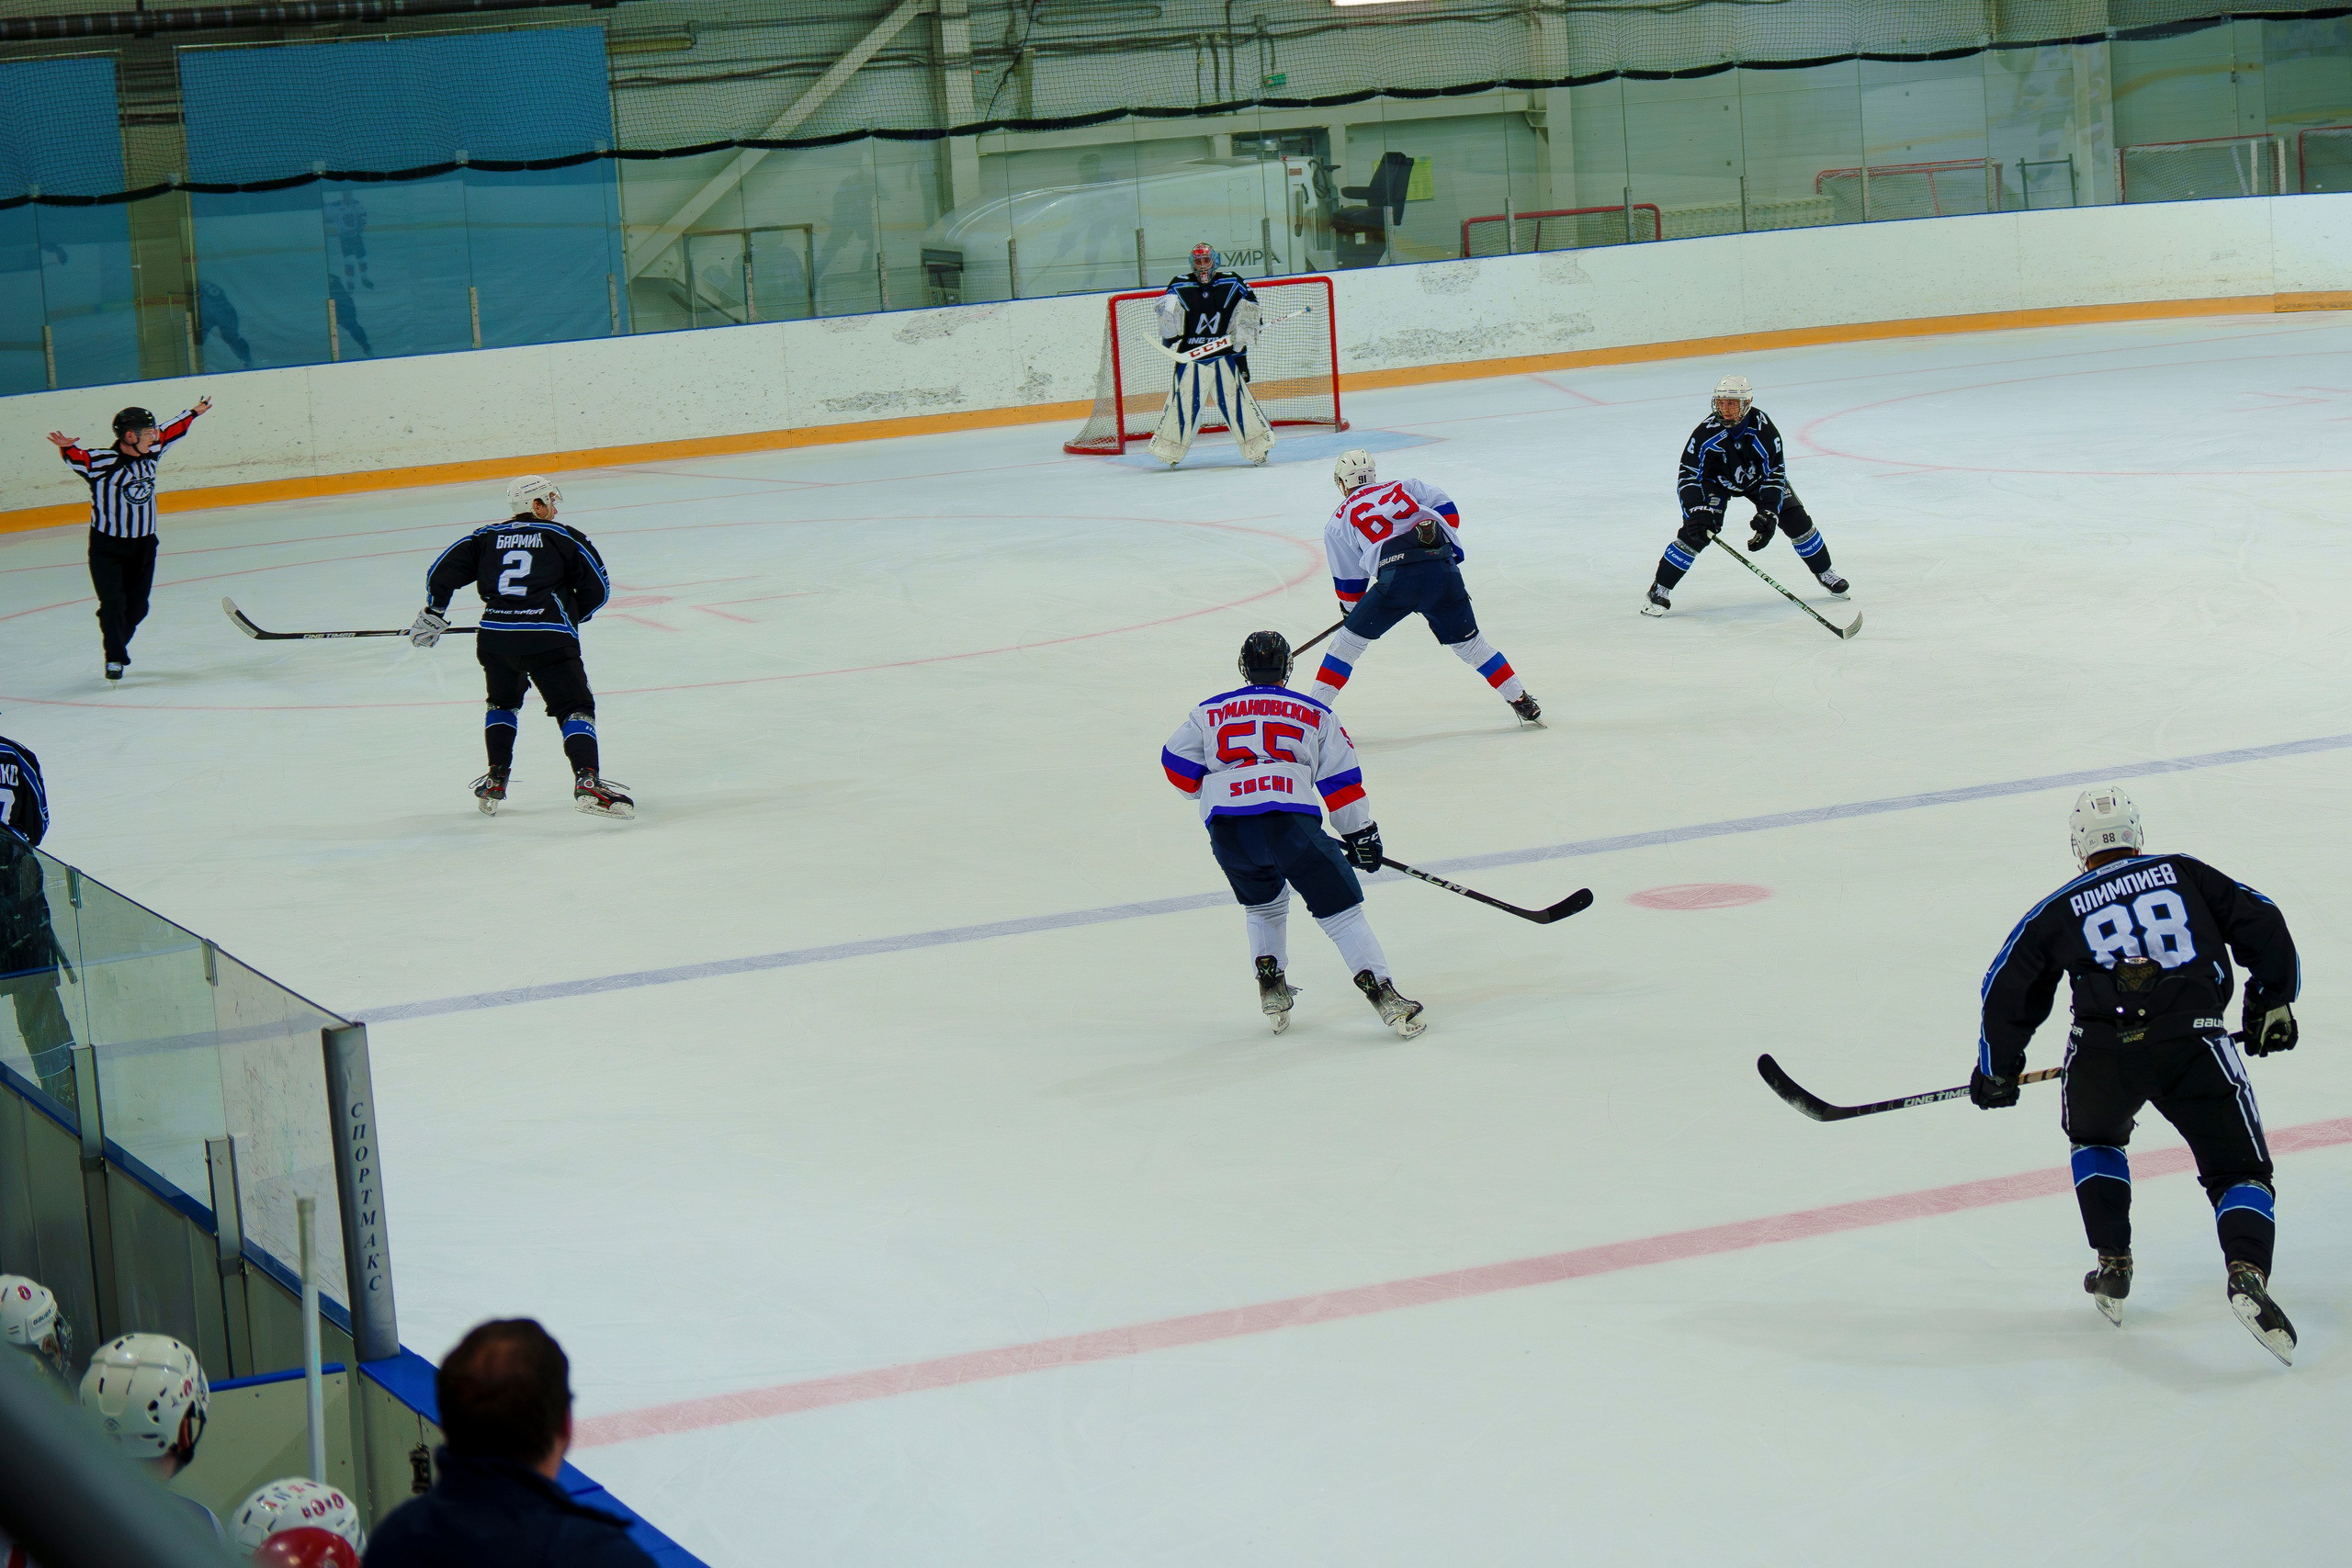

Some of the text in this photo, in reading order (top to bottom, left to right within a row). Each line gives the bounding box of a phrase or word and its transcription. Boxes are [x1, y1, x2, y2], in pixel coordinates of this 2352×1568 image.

[1219, 250, 1281, 267] LYMPA
[1189, 337, 1227, 358] CCM
[1358, 474, 1367, 485] 91
[1350, 482, 1419, 545] 63
[496, 532, 544, 549] БАРМИН
[497, 550, 533, 596] 2
[1206, 699, 1321, 730] ТУМАНОВСКИЙ
[1216, 720, 1305, 769] 55
[1230, 775, 1293, 797] SOCHI
[1358, 832, 1378, 845] CC
[2102, 832, 2116, 843] 88
[1406, 866, 1469, 896] CCM
[2069, 863, 2177, 917] АЛИМПИЕВ
[2082, 888, 2198, 970] 88
[2192, 1018, 2223, 1029] BAU
[1904, 1088, 1971, 1108] ONE TIME
[350, 1101, 381, 1292] СПОРТМАКС
